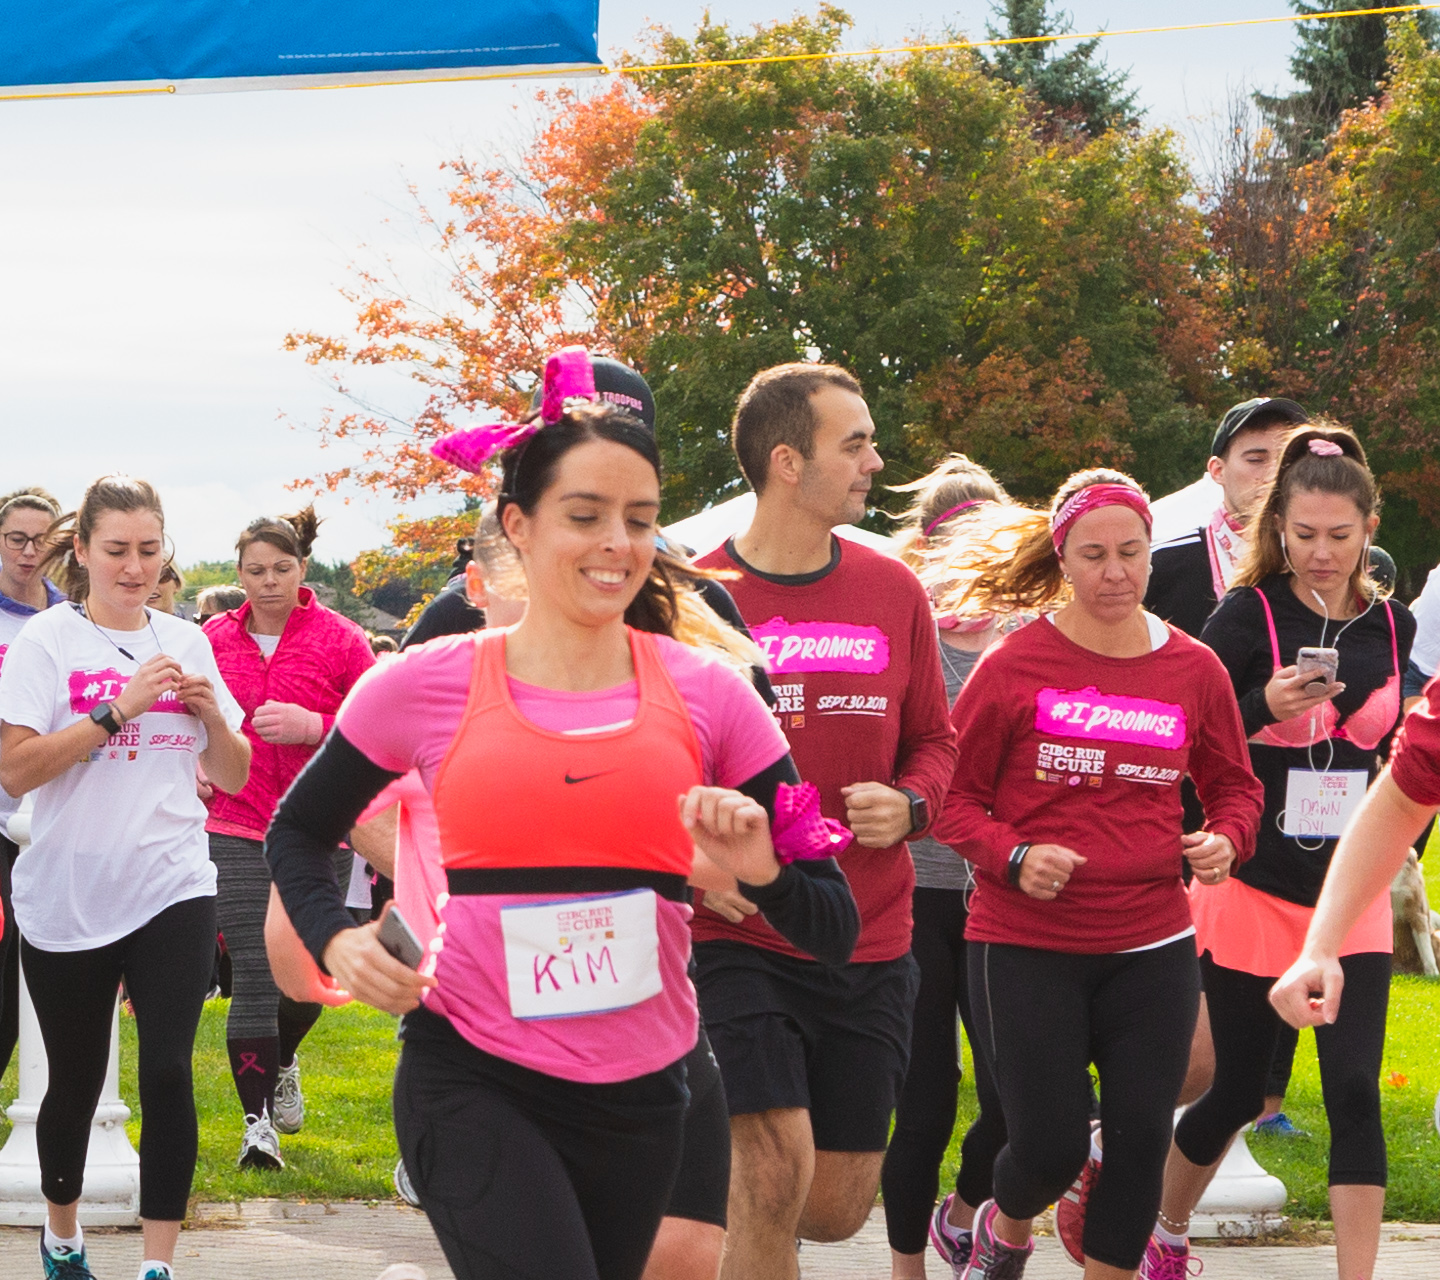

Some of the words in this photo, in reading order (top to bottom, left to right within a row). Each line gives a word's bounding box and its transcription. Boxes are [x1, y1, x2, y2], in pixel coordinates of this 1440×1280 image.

[98, 734, 140, 747] URE
[1038, 742, 1073, 758] CIBC
[1075, 747, 1106, 760] RUN
[1054, 757, 1105, 774] CURE
[573, 917, 614, 931] CURE
